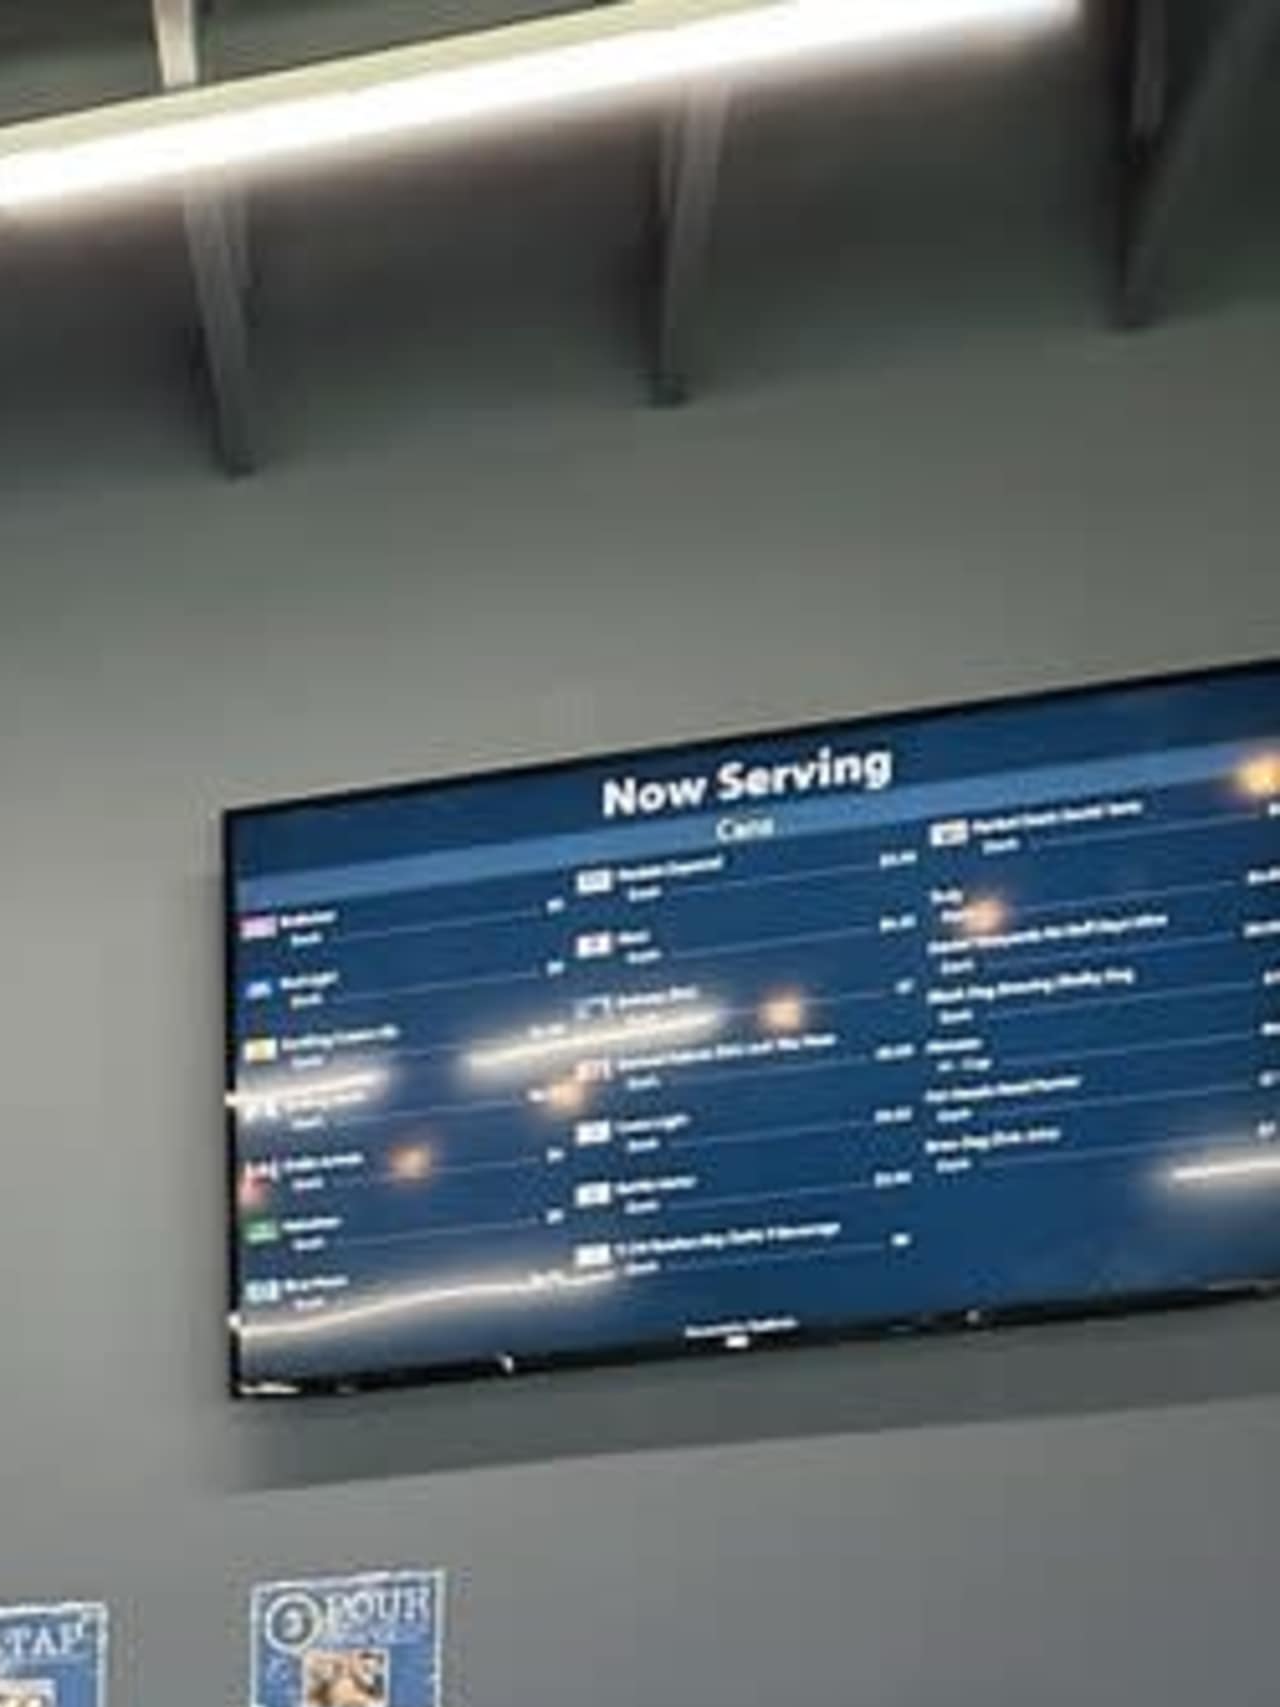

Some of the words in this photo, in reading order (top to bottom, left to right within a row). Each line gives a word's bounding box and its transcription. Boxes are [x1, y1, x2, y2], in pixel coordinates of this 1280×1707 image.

[602, 776, 708, 818] Now
[716, 746, 892, 800] Serving
[324, 1586, 431, 1630] POUR
[3, 1622, 85, 1657] TAP
